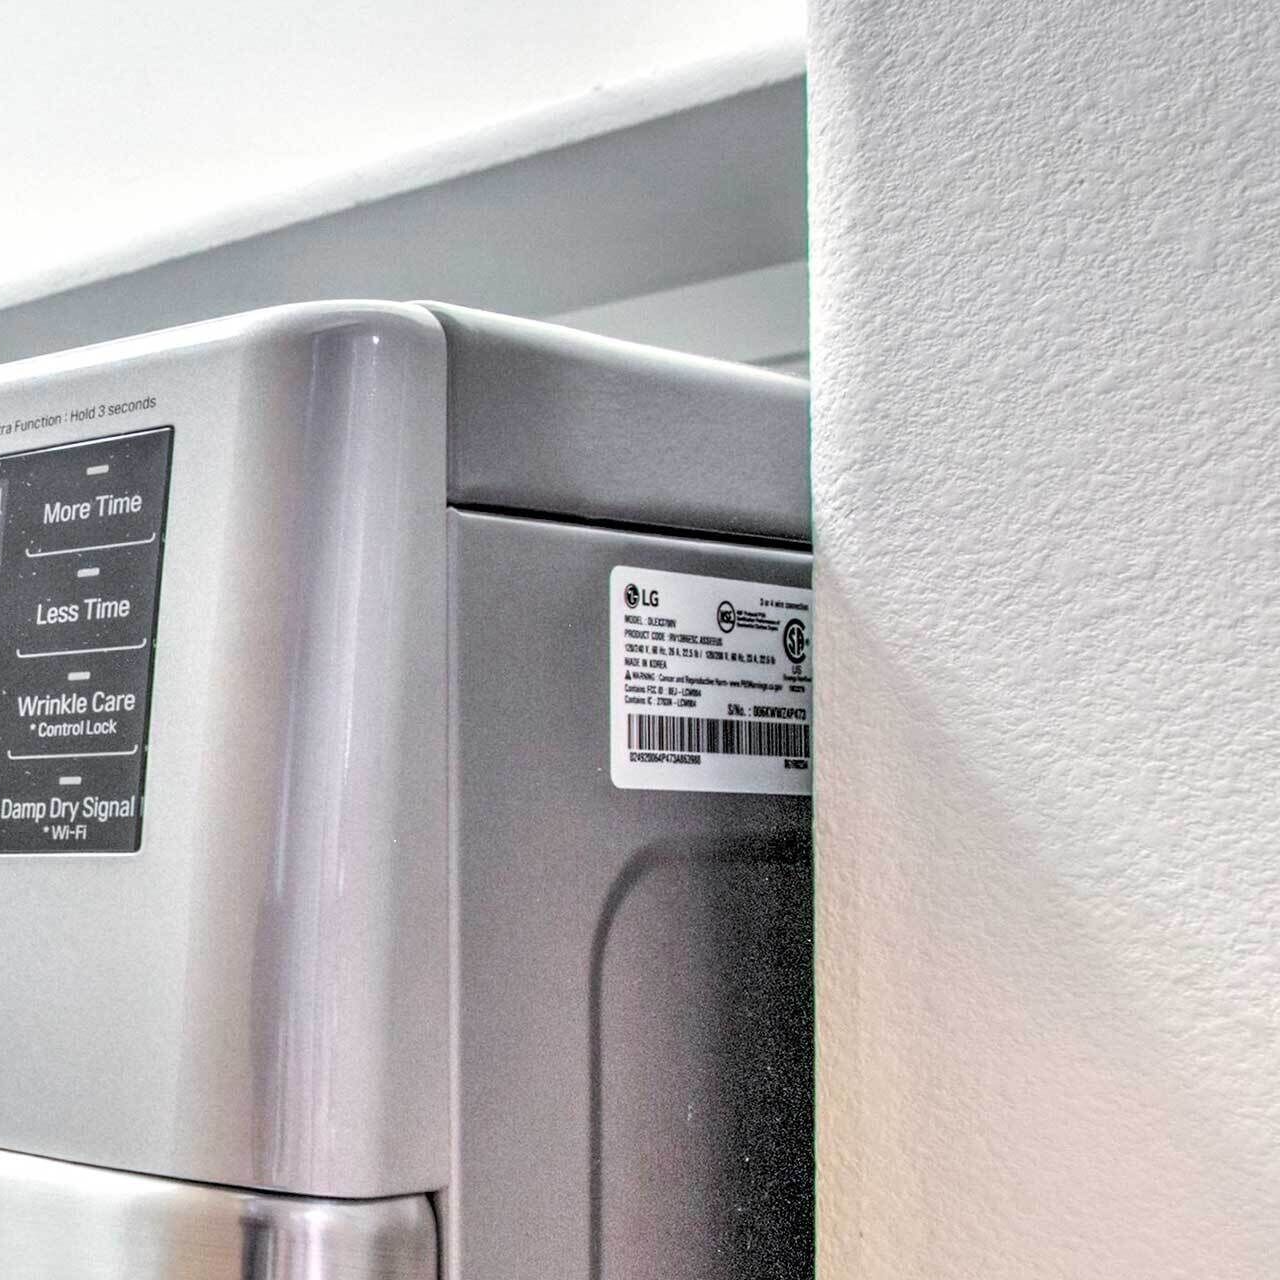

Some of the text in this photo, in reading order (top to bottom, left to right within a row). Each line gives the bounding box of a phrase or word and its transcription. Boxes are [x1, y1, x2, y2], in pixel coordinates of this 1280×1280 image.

[14, 414, 61, 433] Function
[70, 406, 96, 423] Hold
[98, 406, 106, 418] 3
[108, 396, 157, 416] seconds
[43, 493, 142, 524] More Time
[642, 589, 659, 607] LG
[36, 598, 130, 625] Less Time
[17, 691, 136, 716] Wrinkle Care
[38, 719, 118, 737] Control Lock
[0, 795, 135, 823] Damp Dry Signal
[51, 824, 88, 840] Wi-Fi
